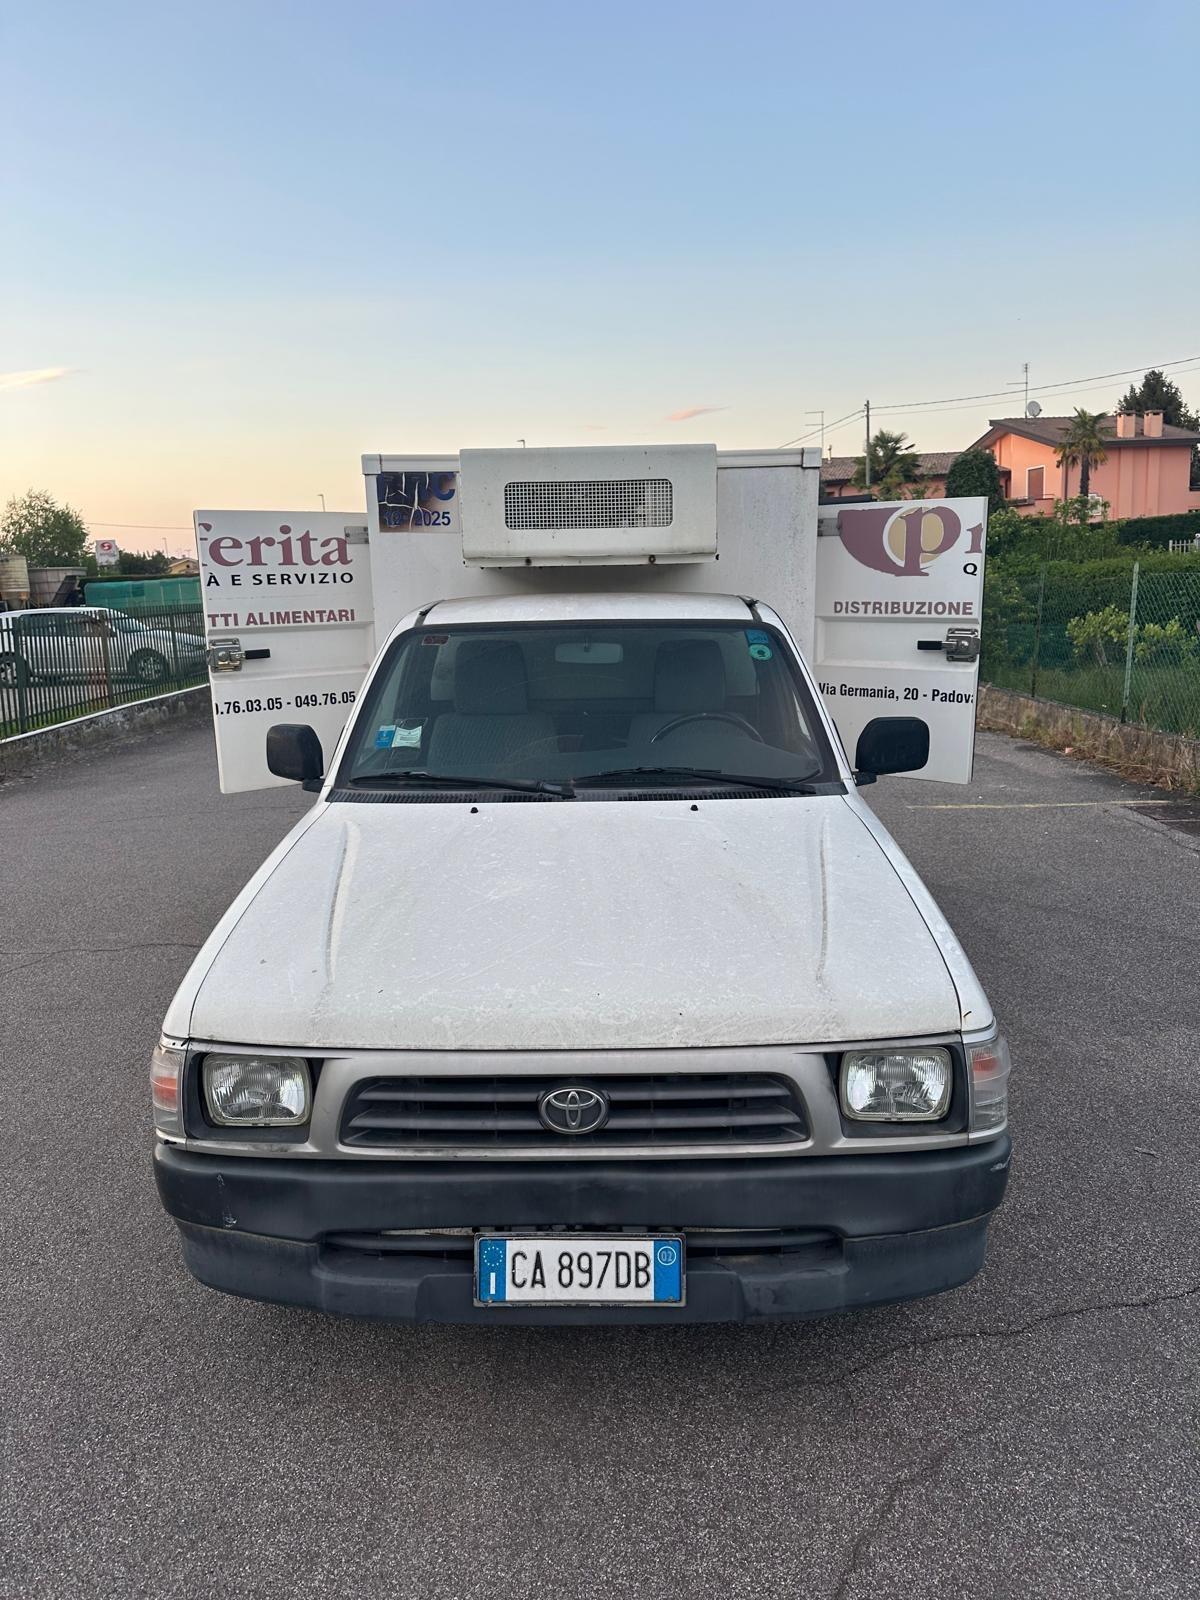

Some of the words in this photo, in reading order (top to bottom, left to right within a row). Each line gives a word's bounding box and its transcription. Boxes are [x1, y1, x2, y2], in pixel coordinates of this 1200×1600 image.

[962, 562, 978, 576] Q
[207, 572, 220, 587] À
[231, 574, 242, 586] E
[252, 572, 354, 586] SERVIZIO
[833, 601, 973, 616] DISTRIBUZIONE
[207, 613, 239, 627] TTI
[245, 609, 355, 626] ALIMENTARI
[295, 690, 356, 708] 049.76.05
[818, 682, 837, 696] Via
[839, 683, 899, 702] Germania,
[903, 687, 919, 701] 20
[511, 1250, 546, 1289] CA
[557, 1250, 651, 1289] 897DB
